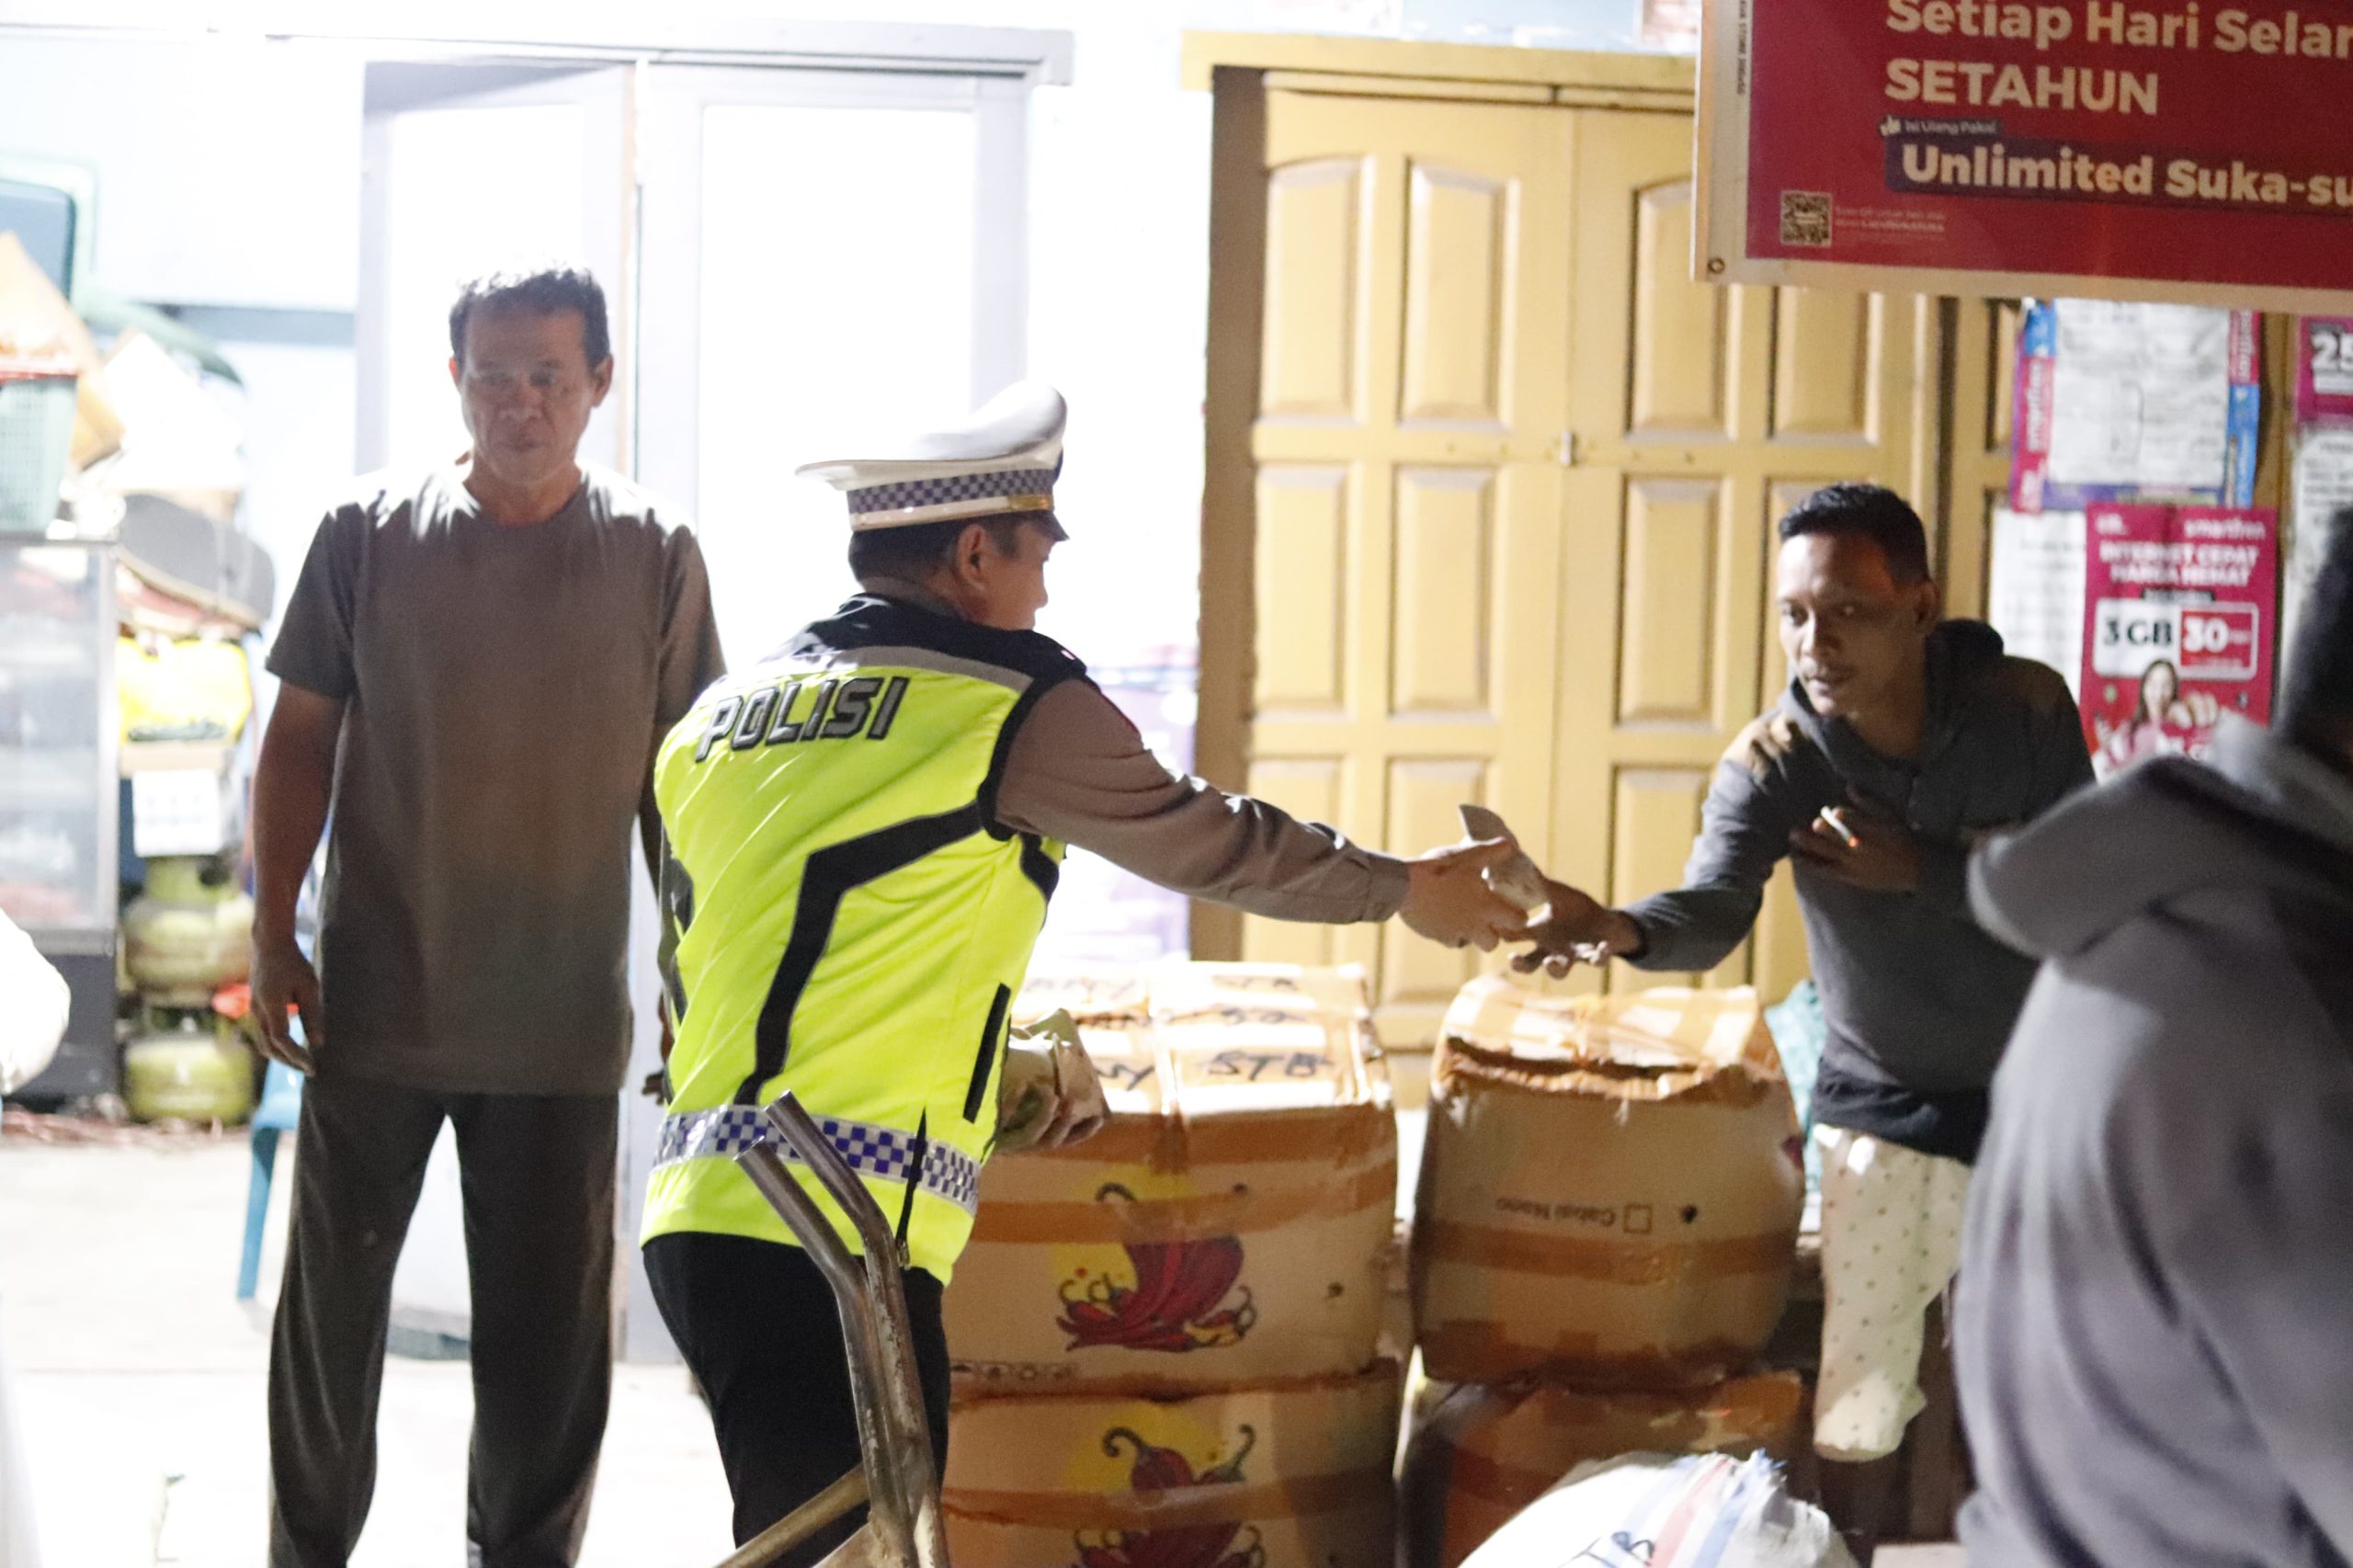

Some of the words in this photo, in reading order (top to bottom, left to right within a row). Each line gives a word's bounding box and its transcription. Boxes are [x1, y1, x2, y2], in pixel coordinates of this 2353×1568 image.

[1886, 0, 2074, 51] Setiap
[2086, 0, 2200, 49] Hari
[1884, 58, 2158, 116] SETAHUN
[1903, 142, 2154, 196] Unlimited
[695, 676, 910, 763] POLISI
